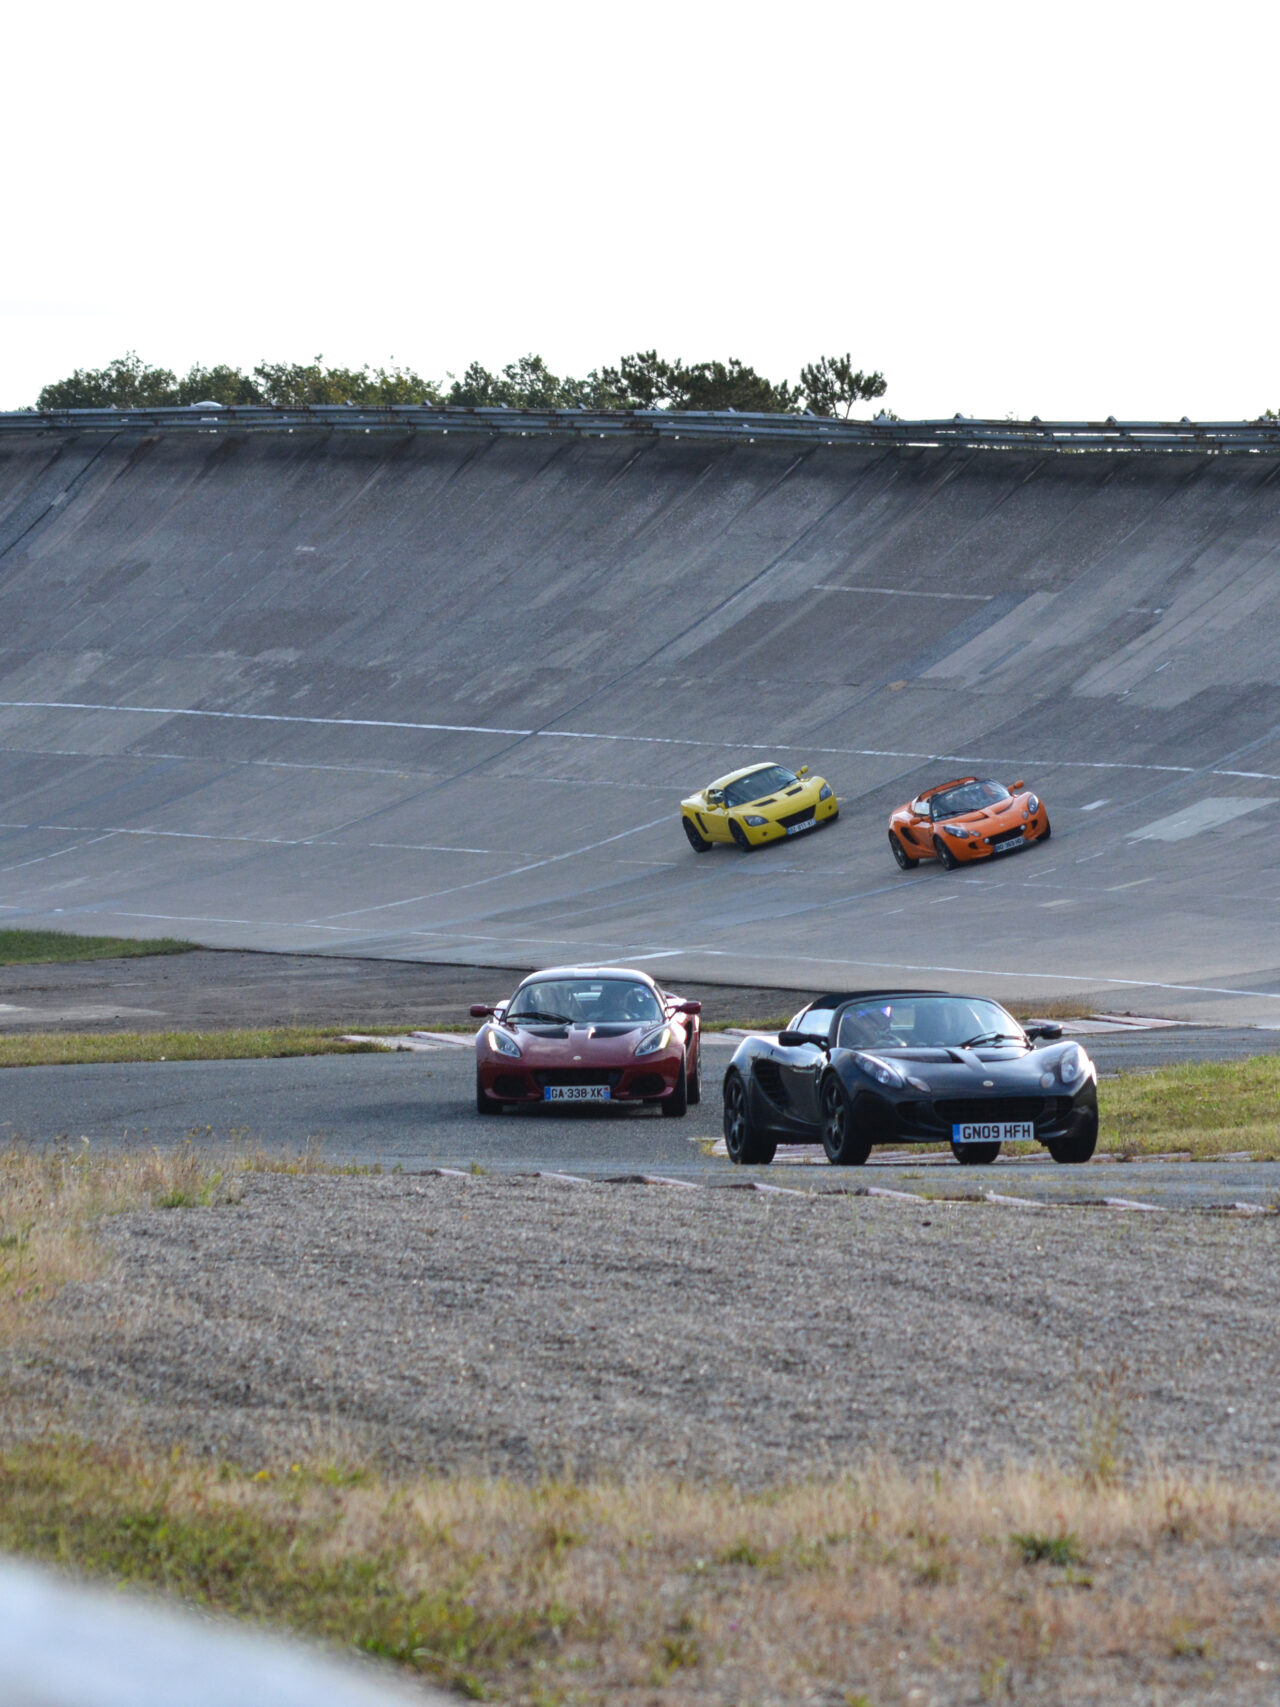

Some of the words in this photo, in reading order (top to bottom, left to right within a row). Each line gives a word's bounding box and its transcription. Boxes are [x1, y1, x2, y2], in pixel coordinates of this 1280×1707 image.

[551, 1087, 603, 1099] GA-338-XK
[962, 1125, 1000, 1140] GN09
[1004, 1124, 1031, 1139] HFH
